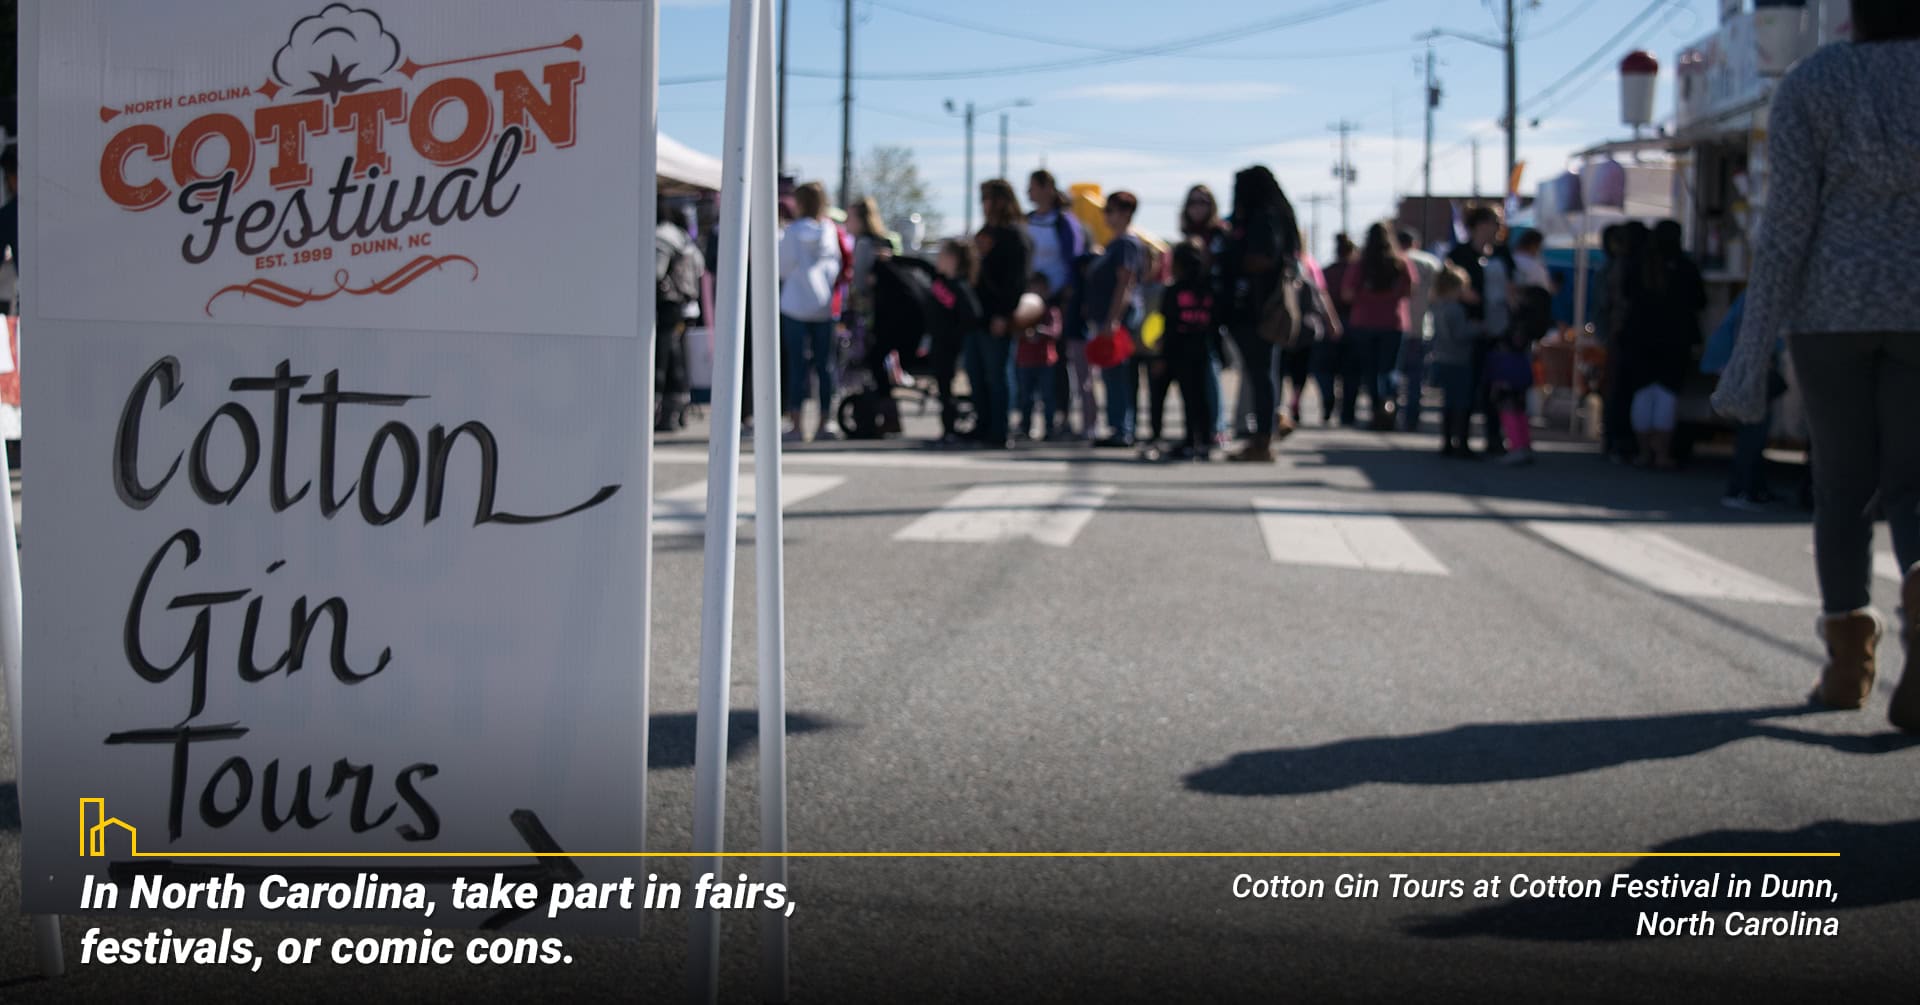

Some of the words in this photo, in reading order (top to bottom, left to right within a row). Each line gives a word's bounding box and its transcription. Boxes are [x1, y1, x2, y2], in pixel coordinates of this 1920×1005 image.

[99, 61, 586, 212] COTTON
[124, 97, 173, 116] NORTH
[177, 86, 252, 107] CAROLINA
[178, 126, 523, 264] Festival
[255, 253, 288, 270] EST.
[293, 247, 333, 265] 1999
[350, 238, 403, 256] DUNN,
[407, 232, 432, 249] NC
[113, 355, 622, 526] Cotton
[123, 528, 392, 727] Gin
[104, 721, 440, 842] Tours
